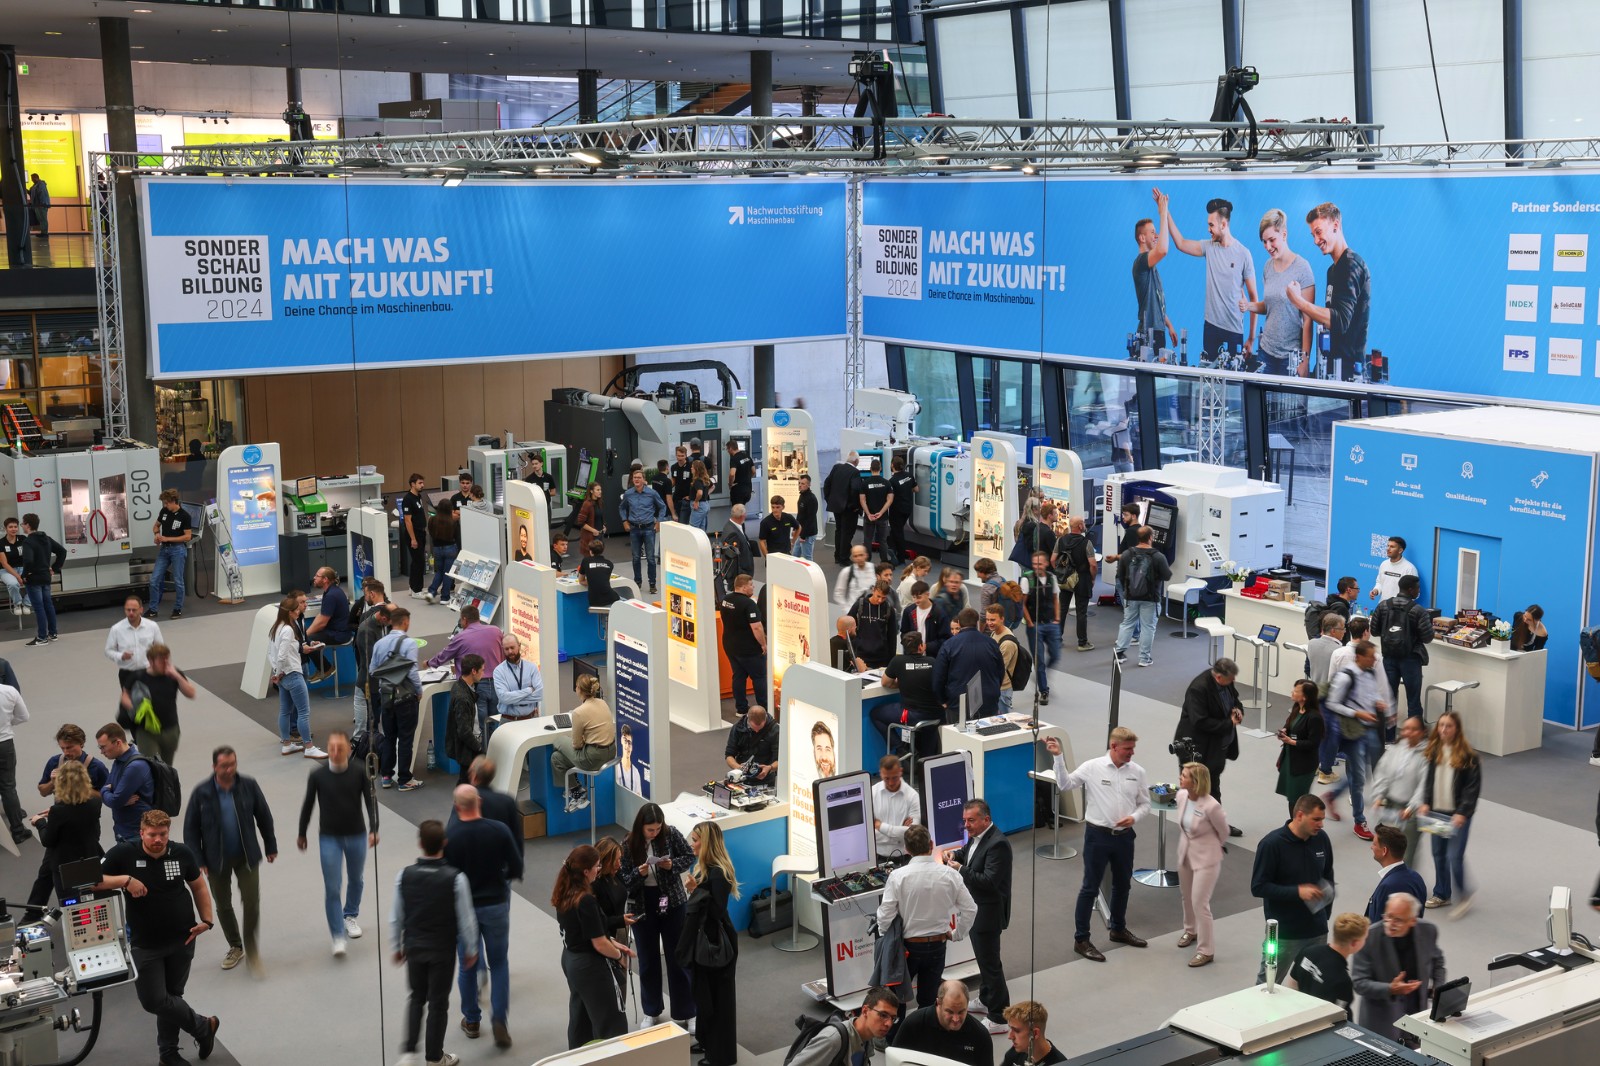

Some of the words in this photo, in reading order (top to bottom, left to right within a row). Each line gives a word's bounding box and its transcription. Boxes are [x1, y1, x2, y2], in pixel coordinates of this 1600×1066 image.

[747, 205, 823, 216] Nachwuchsstiftung
[1511, 202, 1551, 213] Partner
[747, 216, 795, 225] Maschinenbau
[878, 229, 918, 244] SONDER
[928, 230, 985, 255] MACH
[989, 231, 1035, 257] WAS
[184, 239, 260, 257] SONDER
[281, 237, 375, 265] MACH
[382, 236, 450, 264] WAS
[884, 244, 918, 260] SCHAU
[197, 257, 261, 275] SCHAU
[876, 260, 918, 276] BILDUNG
[283, 273, 341, 301] MIT
[350, 268, 493, 299] ZUKUNFT!
[928, 261, 963, 286] MIT
[967, 262, 1066, 292] ZUKUNFT!
[181, 277, 262, 294] BILDUNG
[887, 278, 917, 297] 2024
[928, 289, 947, 299] Deine
[947, 290, 972, 302] Chance
[973, 291, 982, 302] im
[983, 292, 1036, 305] Maschinenbau.
[1509, 300, 1533, 308] INDEX
[207, 298, 263, 319] 2024
[284, 305, 315, 317] Deine
[318, 304, 358, 316] Chance
[361, 303, 374, 314] im
[377, 301, 454, 314] Maschinenbau.
[1508, 349, 1529, 359] FPS
[929, 465, 937, 510] INDEX
[1344, 475, 1368, 486] Beratung
[1395, 480, 1409, 489] Lehr-
[1105, 485, 1113, 512] emco
[1391, 488, 1424, 499] Lernmedien
[1445, 492, 1487, 505] Qualifizierung
[1514, 497, 1540, 508] Projekte
[1541, 500, 1551, 509] für
[1551, 502, 1562, 510] die
[1509, 505, 1540, 516] berufliche
[1541, 510, 1566, 521] Bildung
[783, 599, 810, 615] SolidCAM
[937, 797, 962, 810] SELLER
[836, 940, 854, 962] LN
